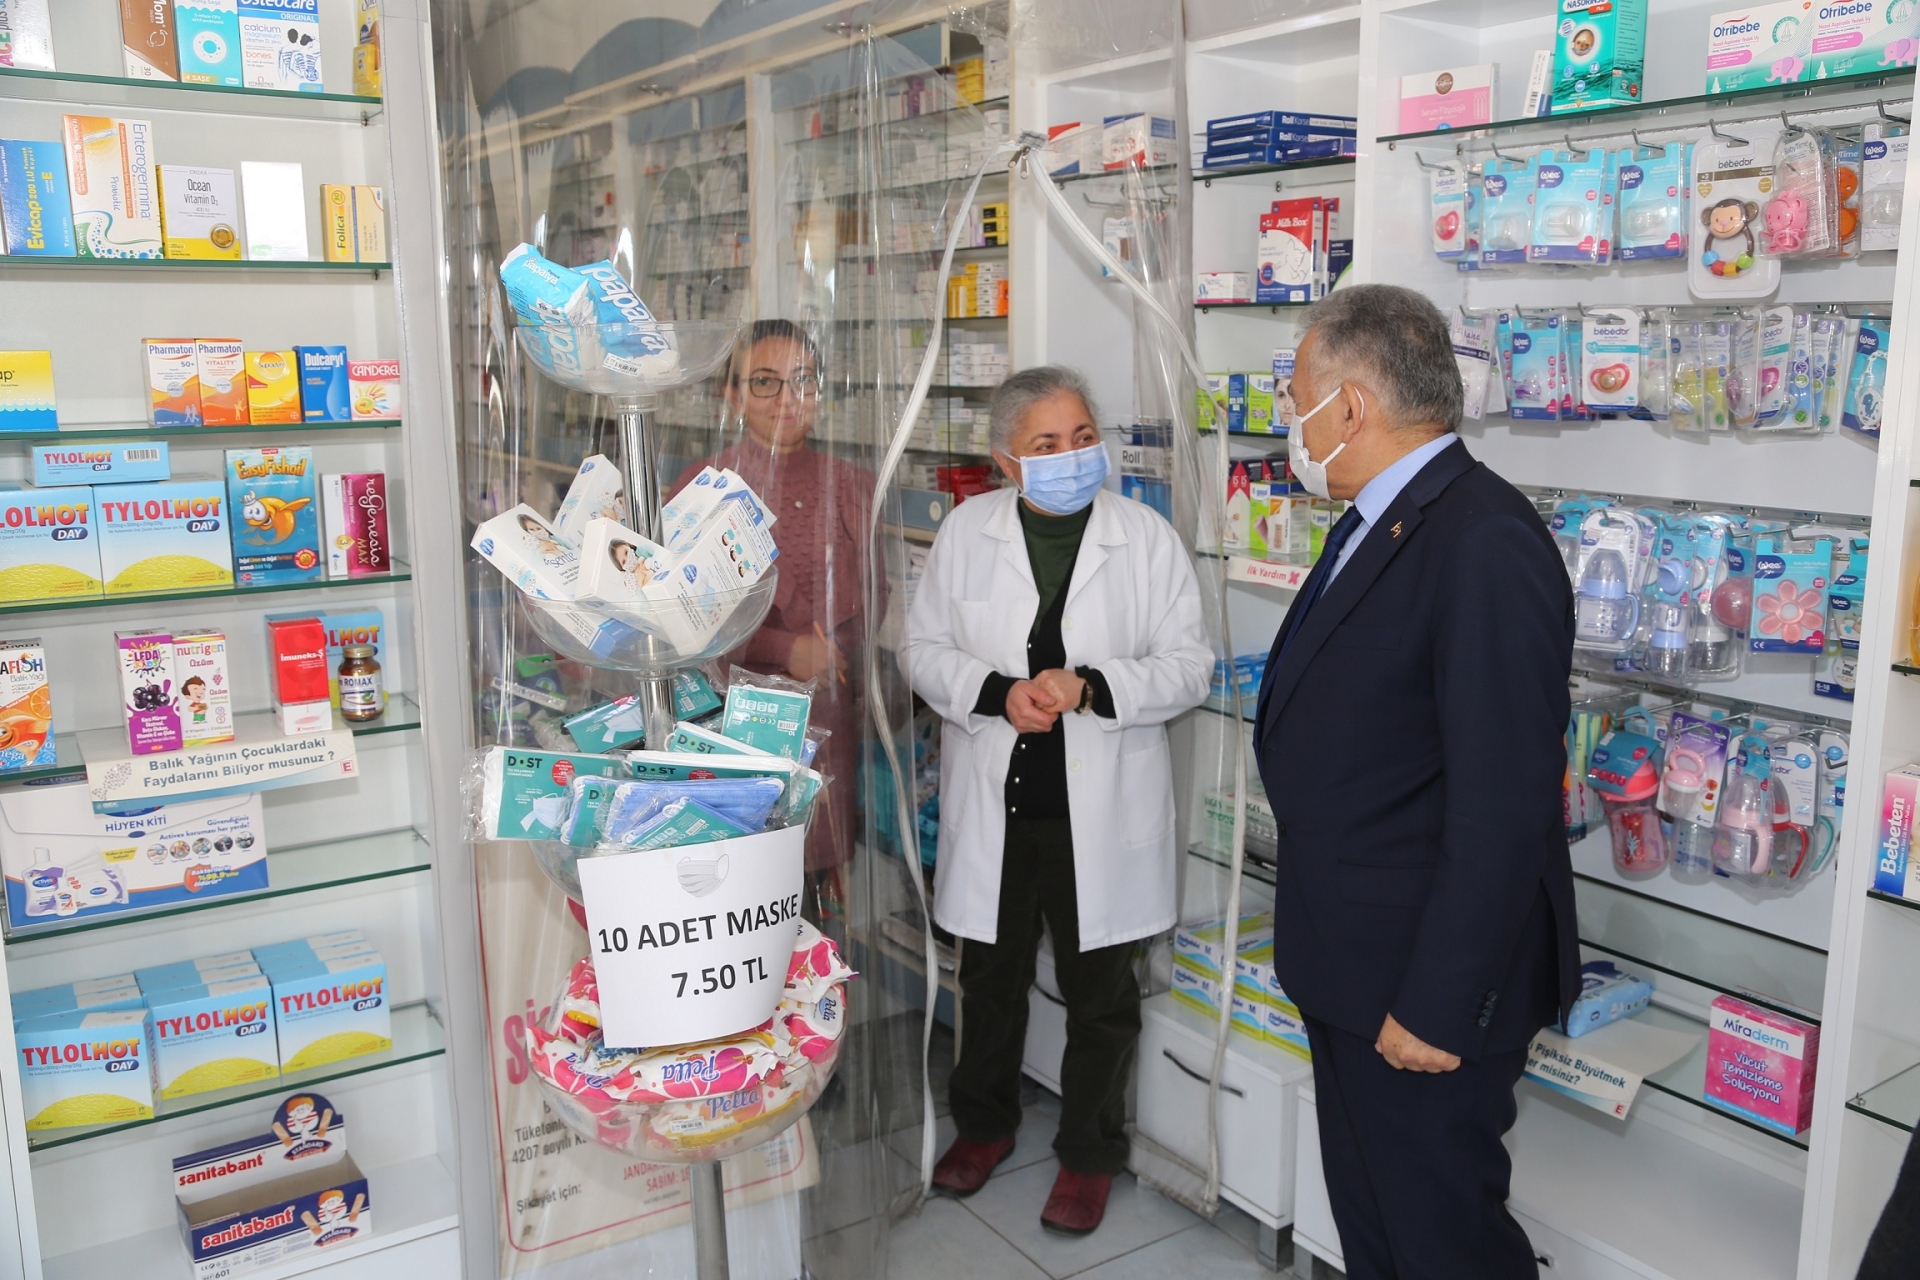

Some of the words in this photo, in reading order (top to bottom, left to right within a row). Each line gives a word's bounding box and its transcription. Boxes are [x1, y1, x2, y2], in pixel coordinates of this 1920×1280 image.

[280, 13, 316, 22] ORIGINAL
[1820, 2, 1873, 19] Otribebe
[244, 24, 281, 33] calcium
[1714, 22, 1760, 38] Otribebe
[246, 51, 272, 59] bones
[193, 75, 211, 84] SAŞE
[1420, 107, 1438, 117] Serum
[1439, 104, 1467, 116] Fizyolojik
[132, 123, 153, 220] Enterogermina
[1718, 158, 1754, 169] bebedor
[28, 184, 37, 200] 200
[110, 176, 121, 211] Probiotic
[187, 179, 211, 192] Ocean
[184, 193, 209, 205] Vitamin
[333, 192, 341, 201] 30
[27, 200, 45, 248] Evicap
[1292, 217, 1308, 227] Box
[336, 215, 346, 249] Folica
[1594, 327, 1630, 336] bebedor
[149, 345, 194, 355] Pharmaton
[198, 344, 242, 354] Pharmaton
[304, 353, 344, 369] Dulcaryl
[352, 365, 400, 377] CANDEREL
[44, 451, 112, 465] TYLOLHOT
[1122, 450, 1140, 463] Roll
[234, 456, 307, 479] EasyFishoil
[102, 497, 220, 522] TYLOLHOT
[58, 529, 82, 540] DAY
[193, 521, 214, 532] DAY
[357, 538, 369, 564] MAX
[1259, 568, 1287, 581] Yardım
[325, 626, 379, 647] LHOT
[134, 650, 160, 661] LEDA
[177, 644, 224, 656] nutrigen
[10, 674, 28, 683] Balık
[29, 673, 45, 682] Yağı
[344, 677, 372, 687] ROMAX
[677, 734, 716, 755] DOST
[150, 758, 184, 771] Balık
[188, 751, 237, 767] Yağının
[241, 738, 327, 760] Çocuklardaki
[508, 756, 543, 769] DOST
[144, 770, 218, 788] Faydalarını
[223, 762, 264, 777] Biliyor
[268, 754, 325, 770] musunuz
[327, 750, 336, 761] ?
[343, 762, 352, 772] E
[637, 764, 677, 775] DOST
[106, 820, 144, 832] HİJYEN
[147, 816, 167, 828] KİTİ
[207, 817, 249, 827] Güvendiğiniz
[160, 833, 184, 841] Activex
[186, 829, 216, 838] koruması
[230, 823, 250, 833] yerde!
[1880, 797, 1905, 876] Bebeten
[598, 927, 628, 953] 10
[638, 914, 717, 950] ADET
[726, 893, 799, 937] MASKE
[671, 963, 736, 999] 7.50
[742, 956, 769, 985] TL
[280, 977, 383, 1014] TYLOLHOT
[357, 998, 379, 1012] DAY
[156, 1001, 268, 1038] TYLOLHOT
[240, 1023, 262, 1037] DAY
[1723, 1018, 1789, 1051] Miraderm
[22, 1038, 140, 1066] TYLOLHOT
[111, 1061, 134, 1072] DAY
[1535, 1043, 1573, 1066] Pişiksiz
[1574, 1059, 1627, 1089] Büyütmek
[1733, 1051, 1769, 1073] Vücut
[662, 1056, 721, 1085] Pella
[1540, 1062, 1581, 1085] misiniz?
[1722, 1059, 1784, 1092] Temizleme
[1722, 1073, 1780, 1106] Solüsyonu
[706, 1088, 761, 1119] Pella
[1615, 1104, 1624, 1115] E
[291, 1140, 325, 1156] STANDARD
[512, 1145, 539, 1164] 4207
[543, 1137, 571, 1156] sayılı
[179, 1153, 263, 1186] sanitabant
[646, 1172, 679, 1192] SABİM:
[559, 1184, 582, 1201] için:
[202, 1208, 294, 1250] sanitabant
[214, 1268, 230, 1280] 601
